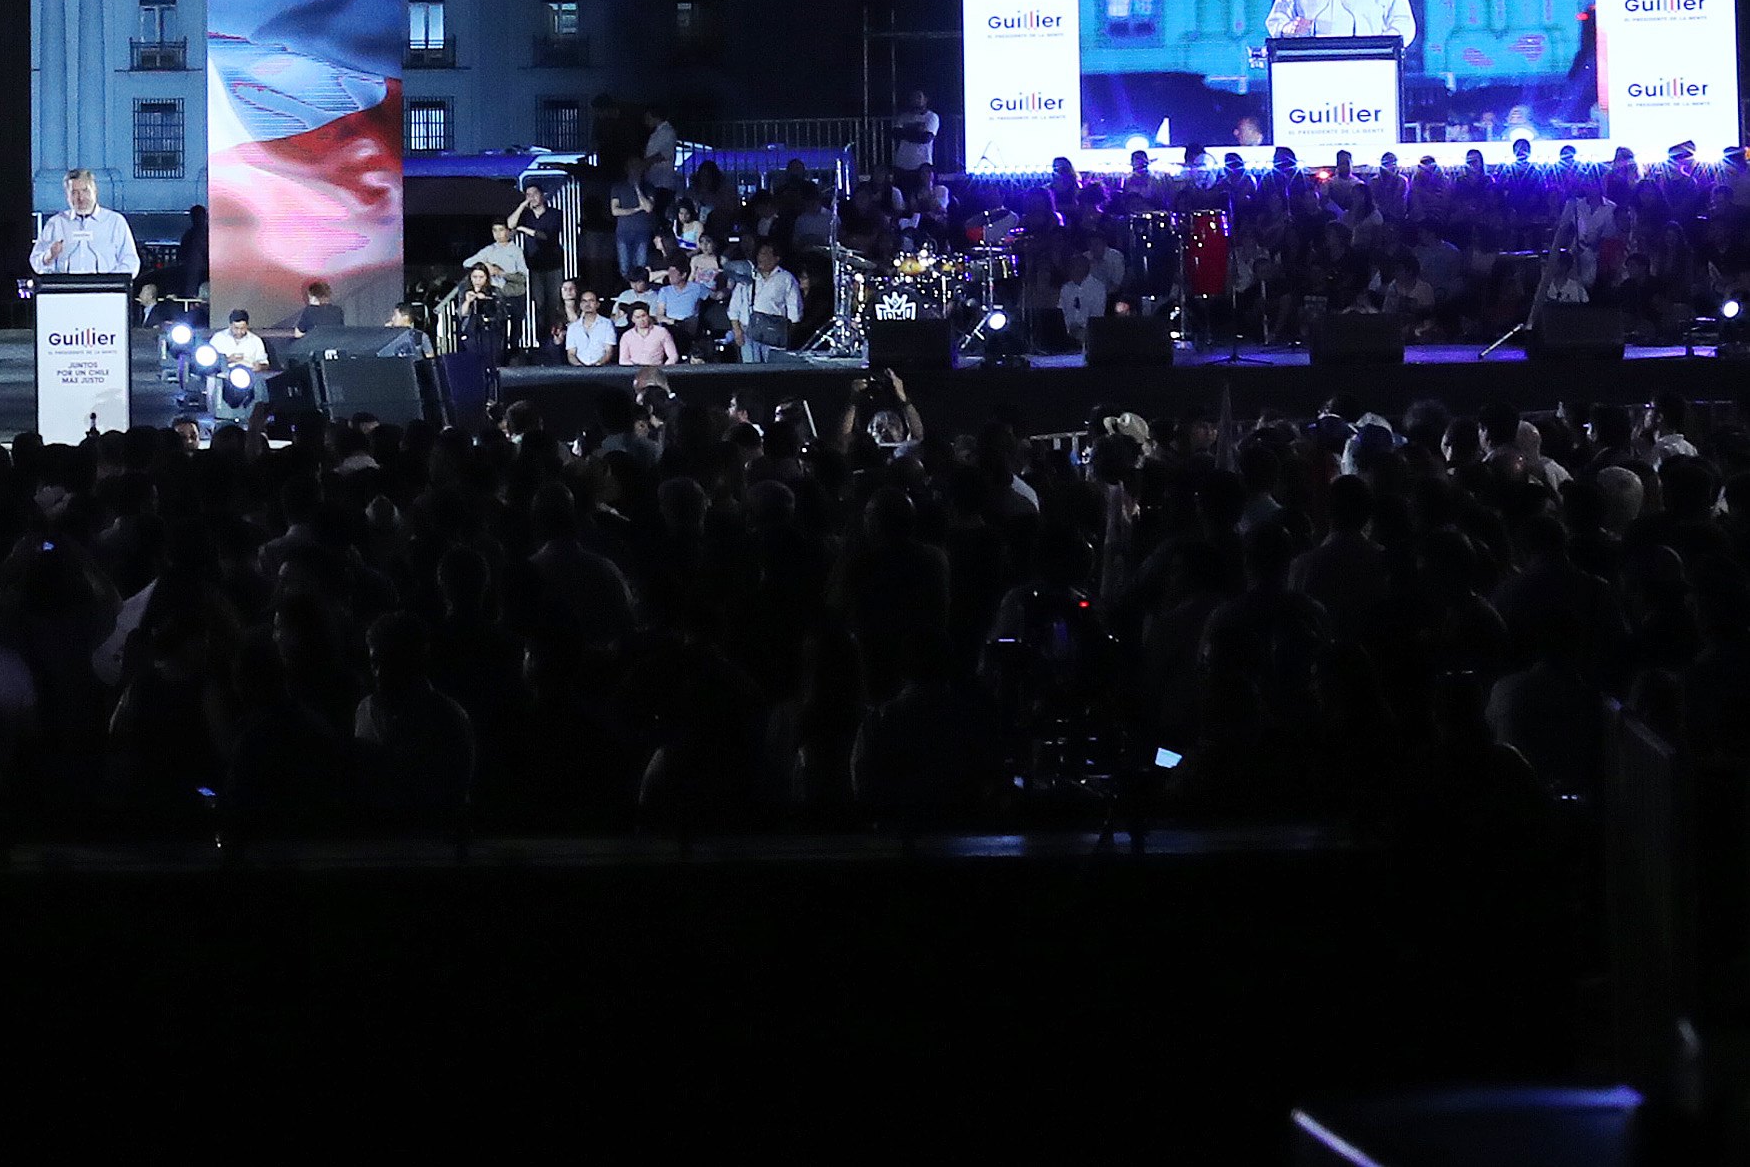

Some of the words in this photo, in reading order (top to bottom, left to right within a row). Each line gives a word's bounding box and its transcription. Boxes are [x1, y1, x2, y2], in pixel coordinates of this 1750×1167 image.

[988, 9, 1062, 31] Guillier
[1628, 77, 1708, 100] Guillier
[990, 91, 1064, 113] Guillier
[1289, 101, 1382, 125] Guillier
[49, 327, 117, 349] Guillier
[57, 369, 73, 377] POR
